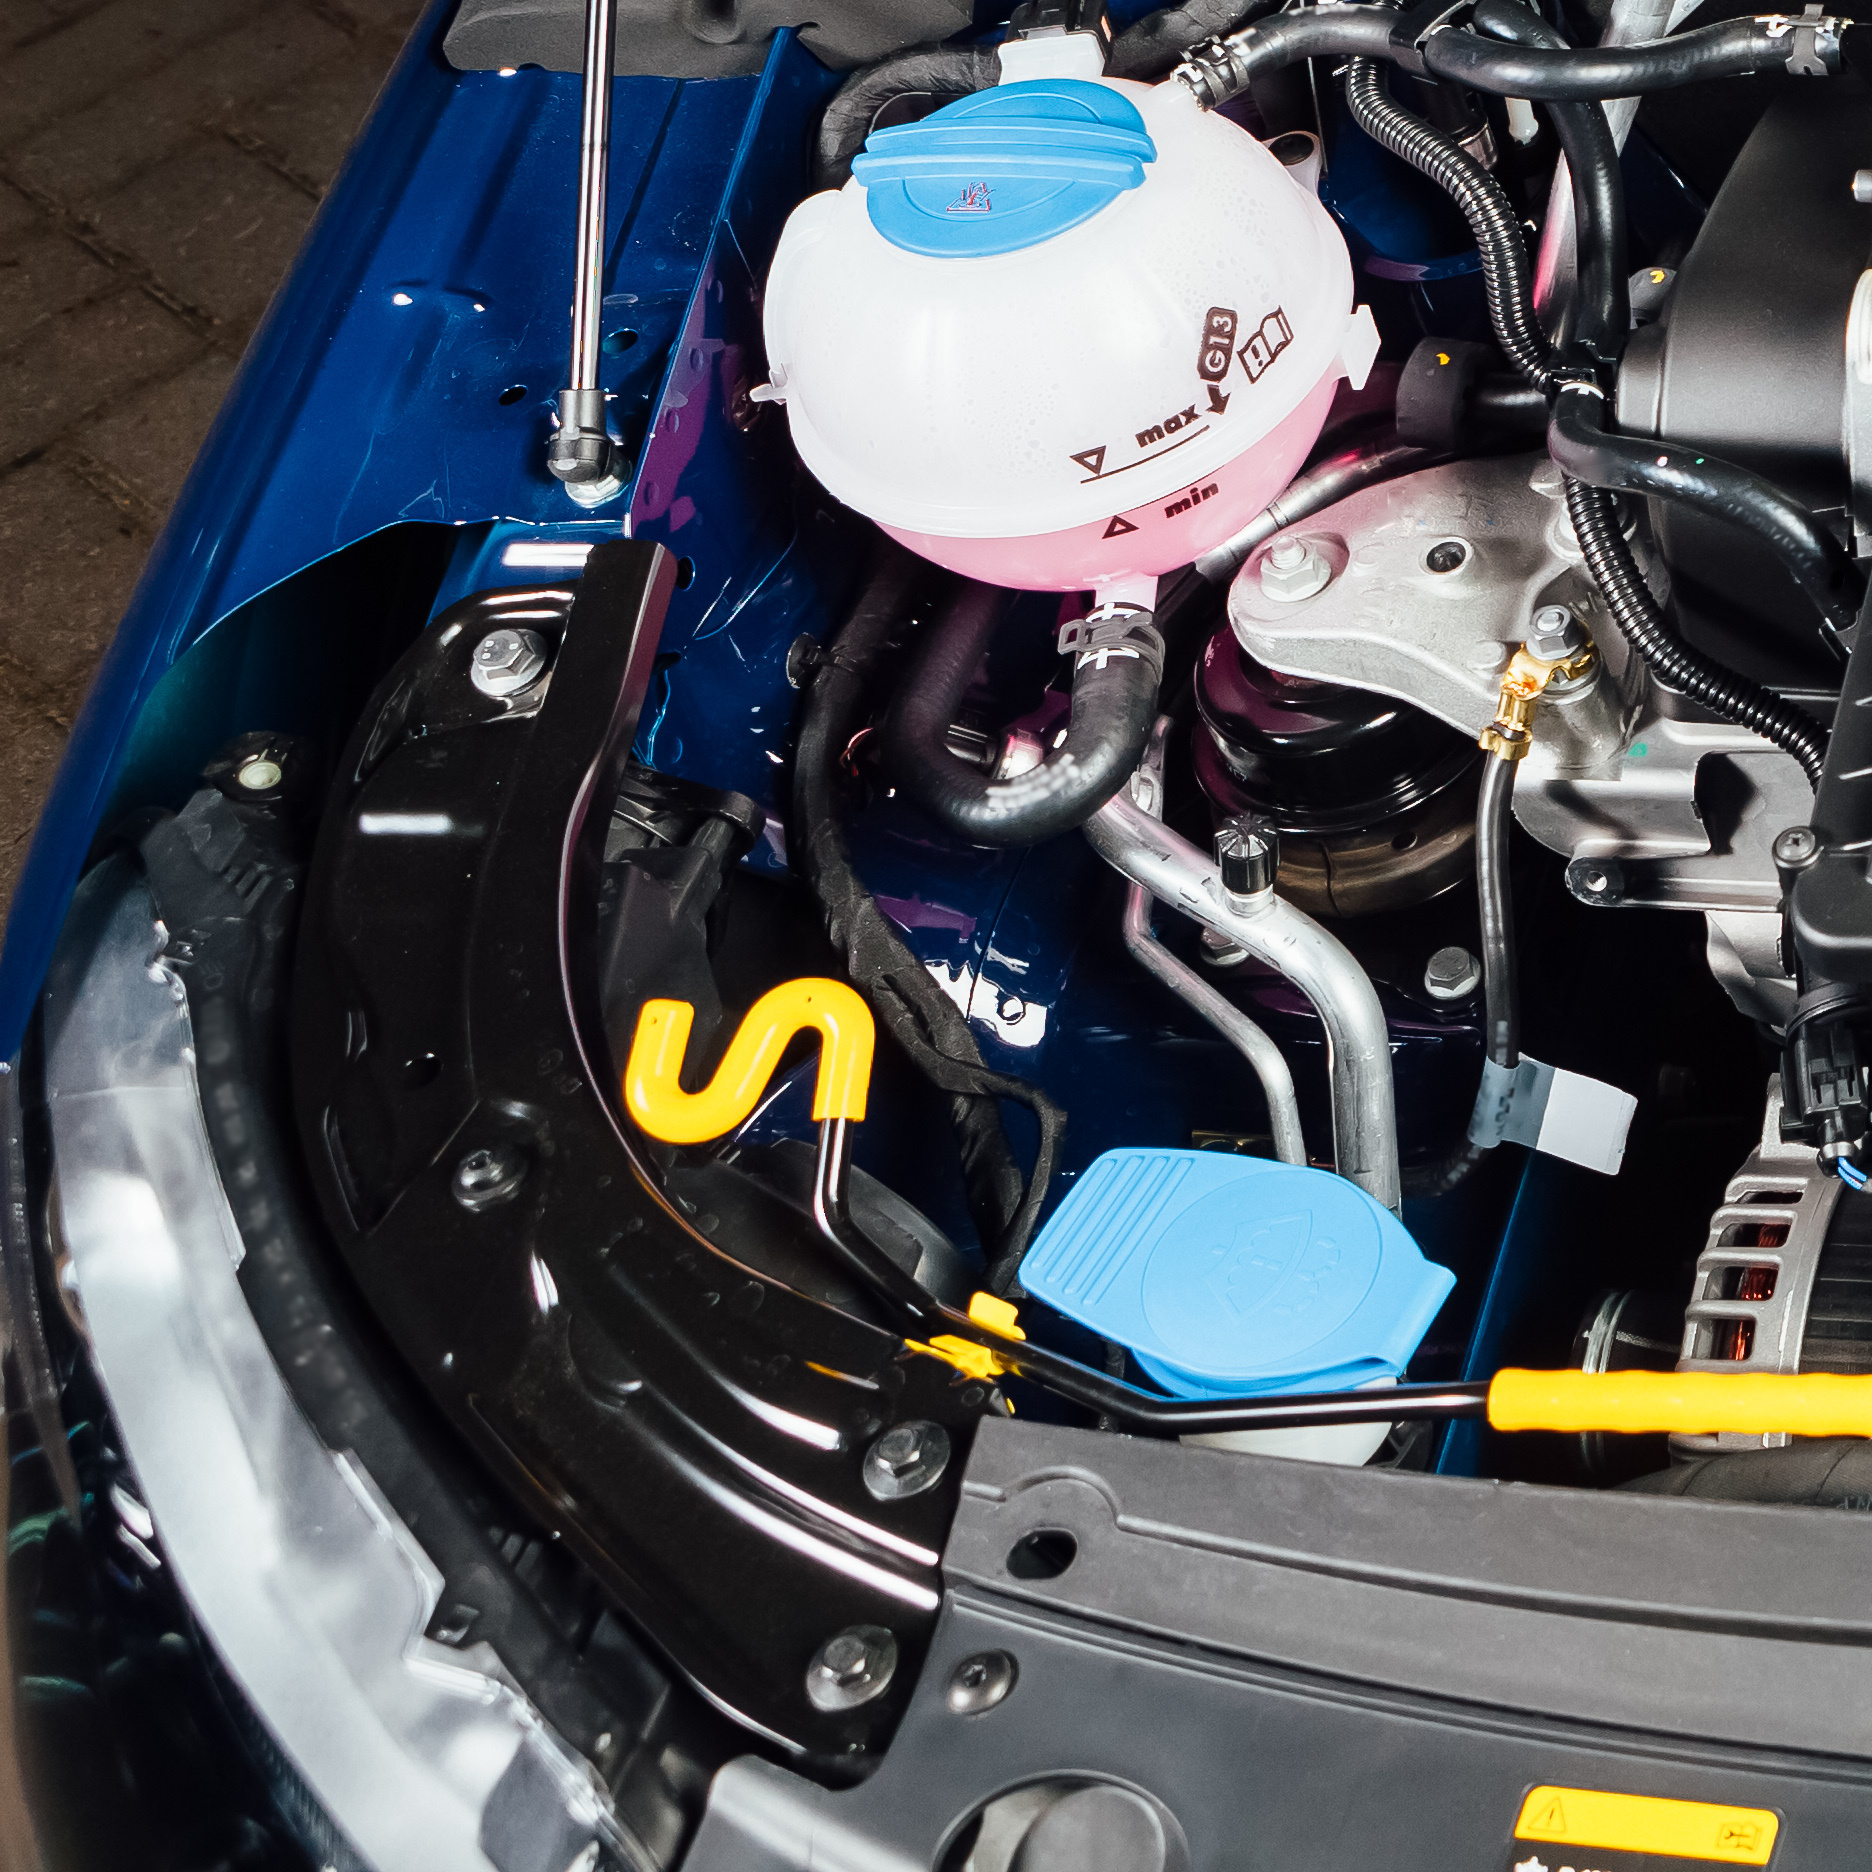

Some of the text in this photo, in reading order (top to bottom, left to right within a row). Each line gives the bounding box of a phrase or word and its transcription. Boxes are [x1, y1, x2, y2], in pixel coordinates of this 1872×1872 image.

[1205, 314, 1233, 373] G13
[1135, 403, 1202, 448] max
[1163, 481, 1220, 519] min
